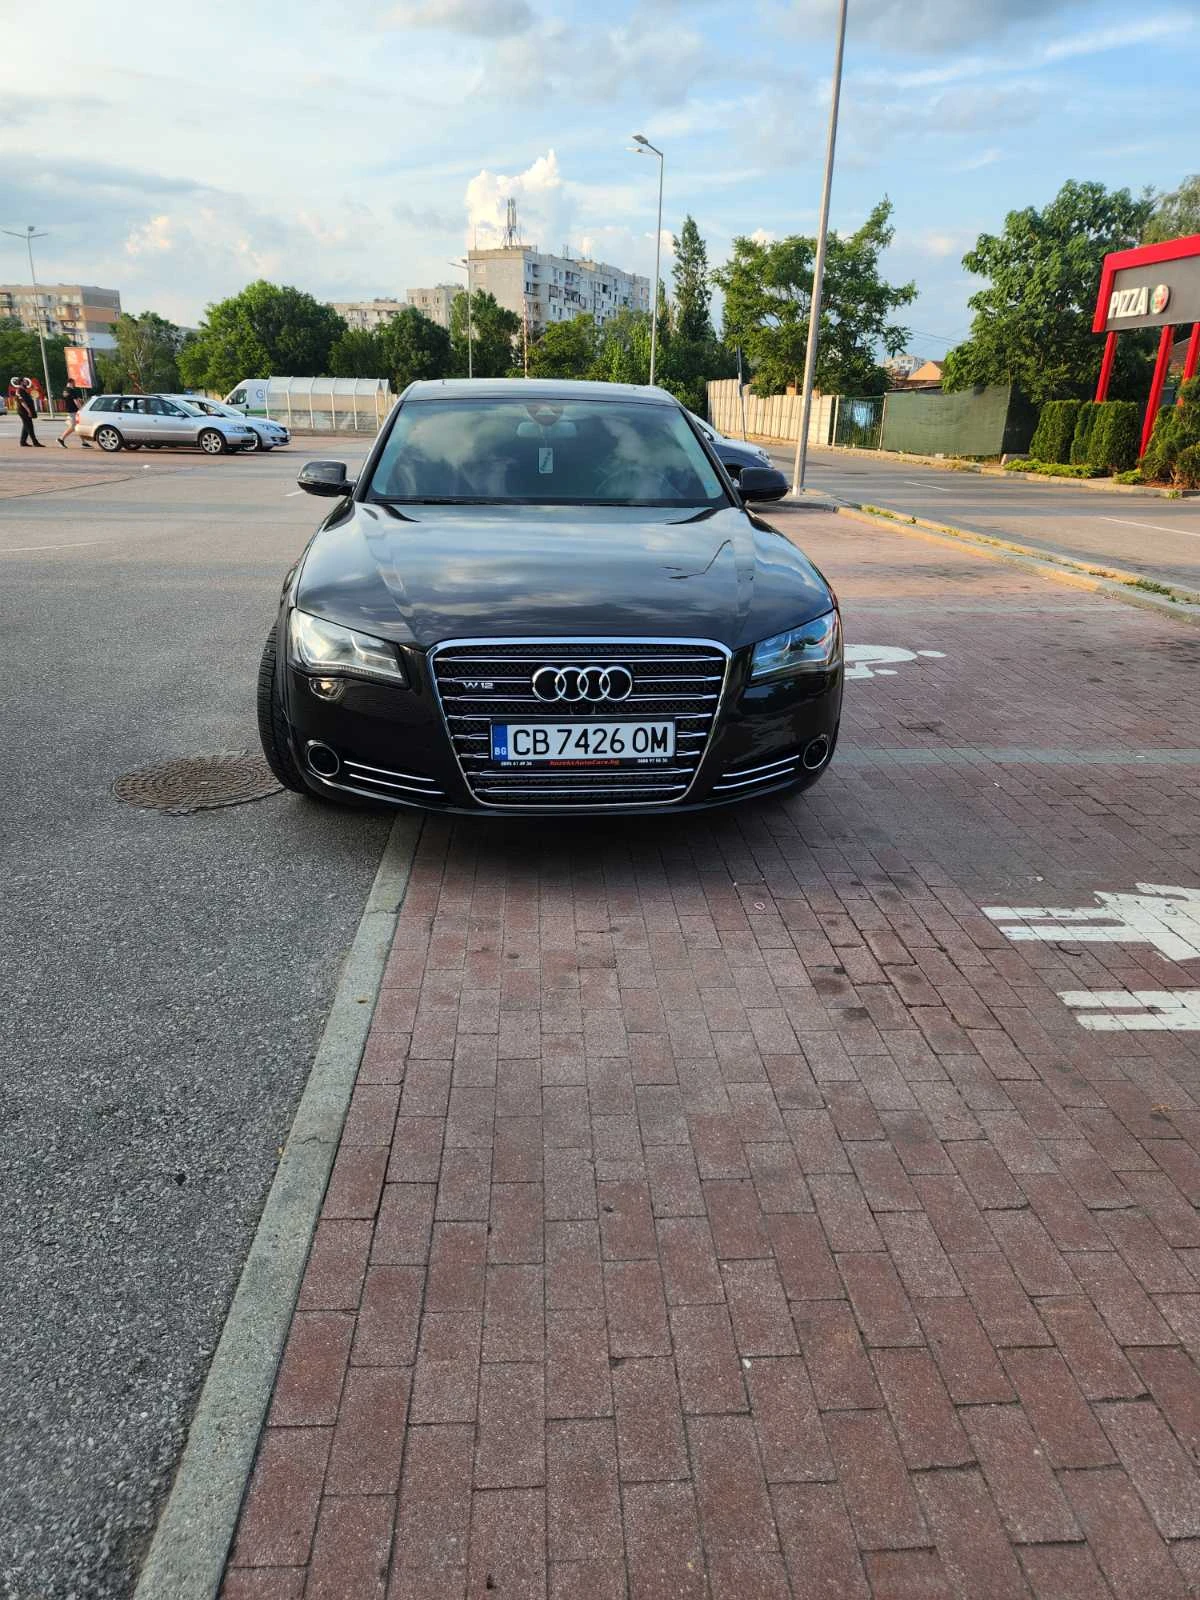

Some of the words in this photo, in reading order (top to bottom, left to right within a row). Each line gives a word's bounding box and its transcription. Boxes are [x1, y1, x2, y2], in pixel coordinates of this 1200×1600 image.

[1107, 286, 1149, 319] PIZZA
[494, 747, 507, 755] BG
[513, 729, 550, 756] CB
[557, 728, 625, 755] 7426
[632, 726, 668, 754] OM
